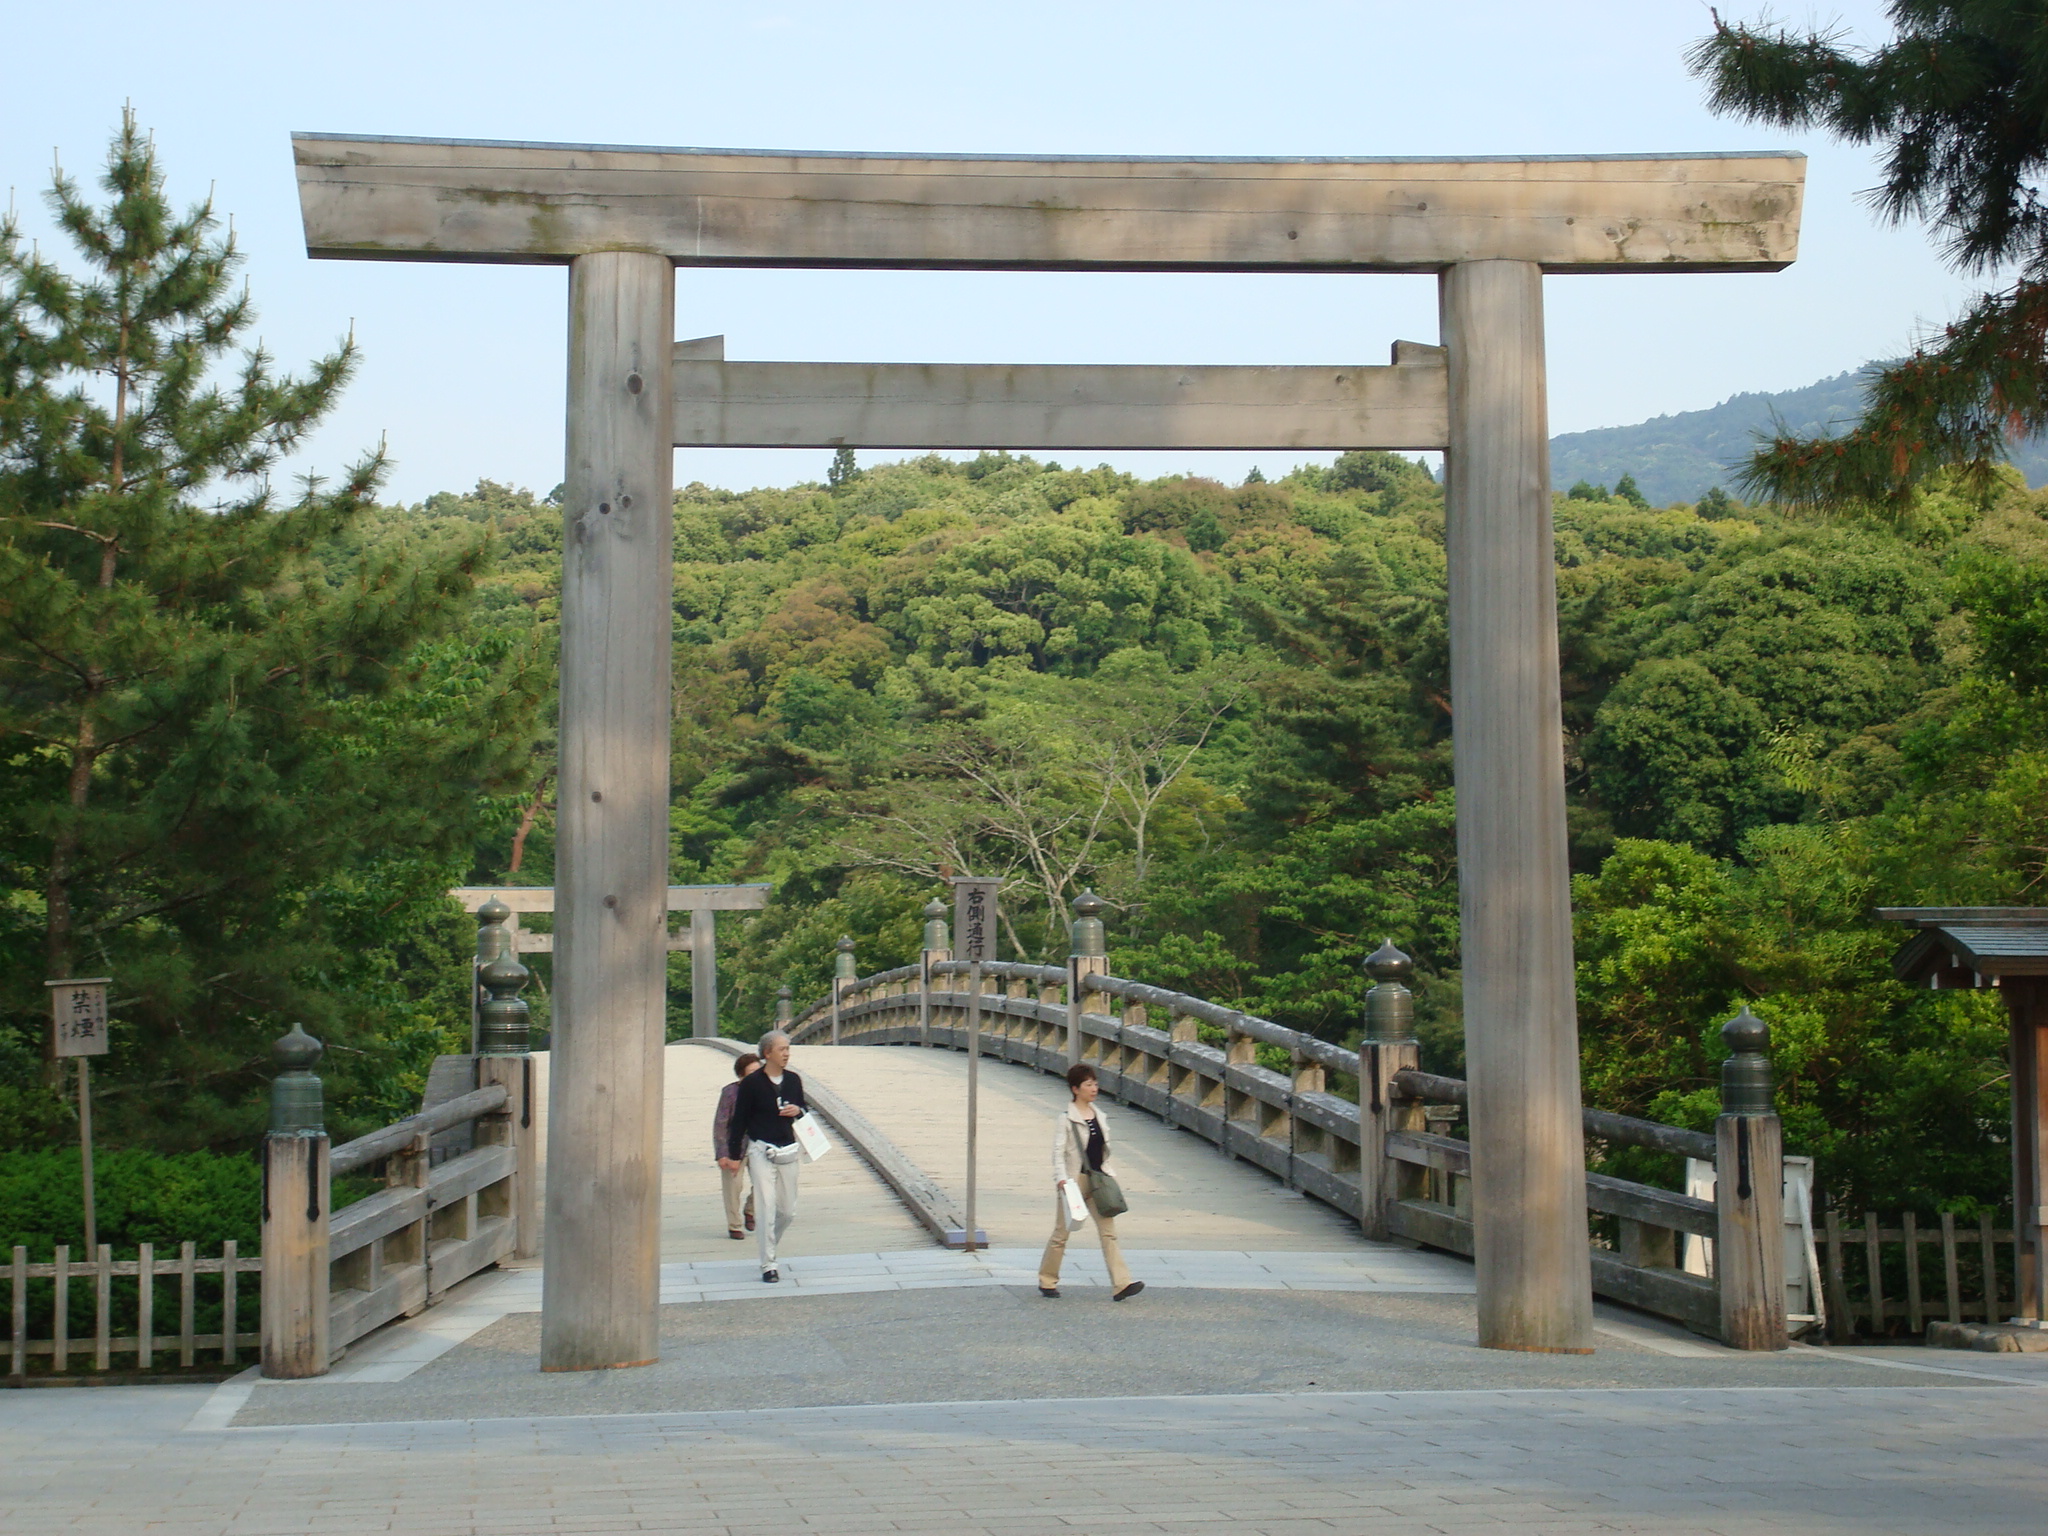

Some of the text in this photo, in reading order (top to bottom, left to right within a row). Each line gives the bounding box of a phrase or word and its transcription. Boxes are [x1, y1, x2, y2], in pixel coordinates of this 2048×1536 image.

[966, 888, 985, 957] 右側通行
[71, 990, 95, 1037] 禁煙
